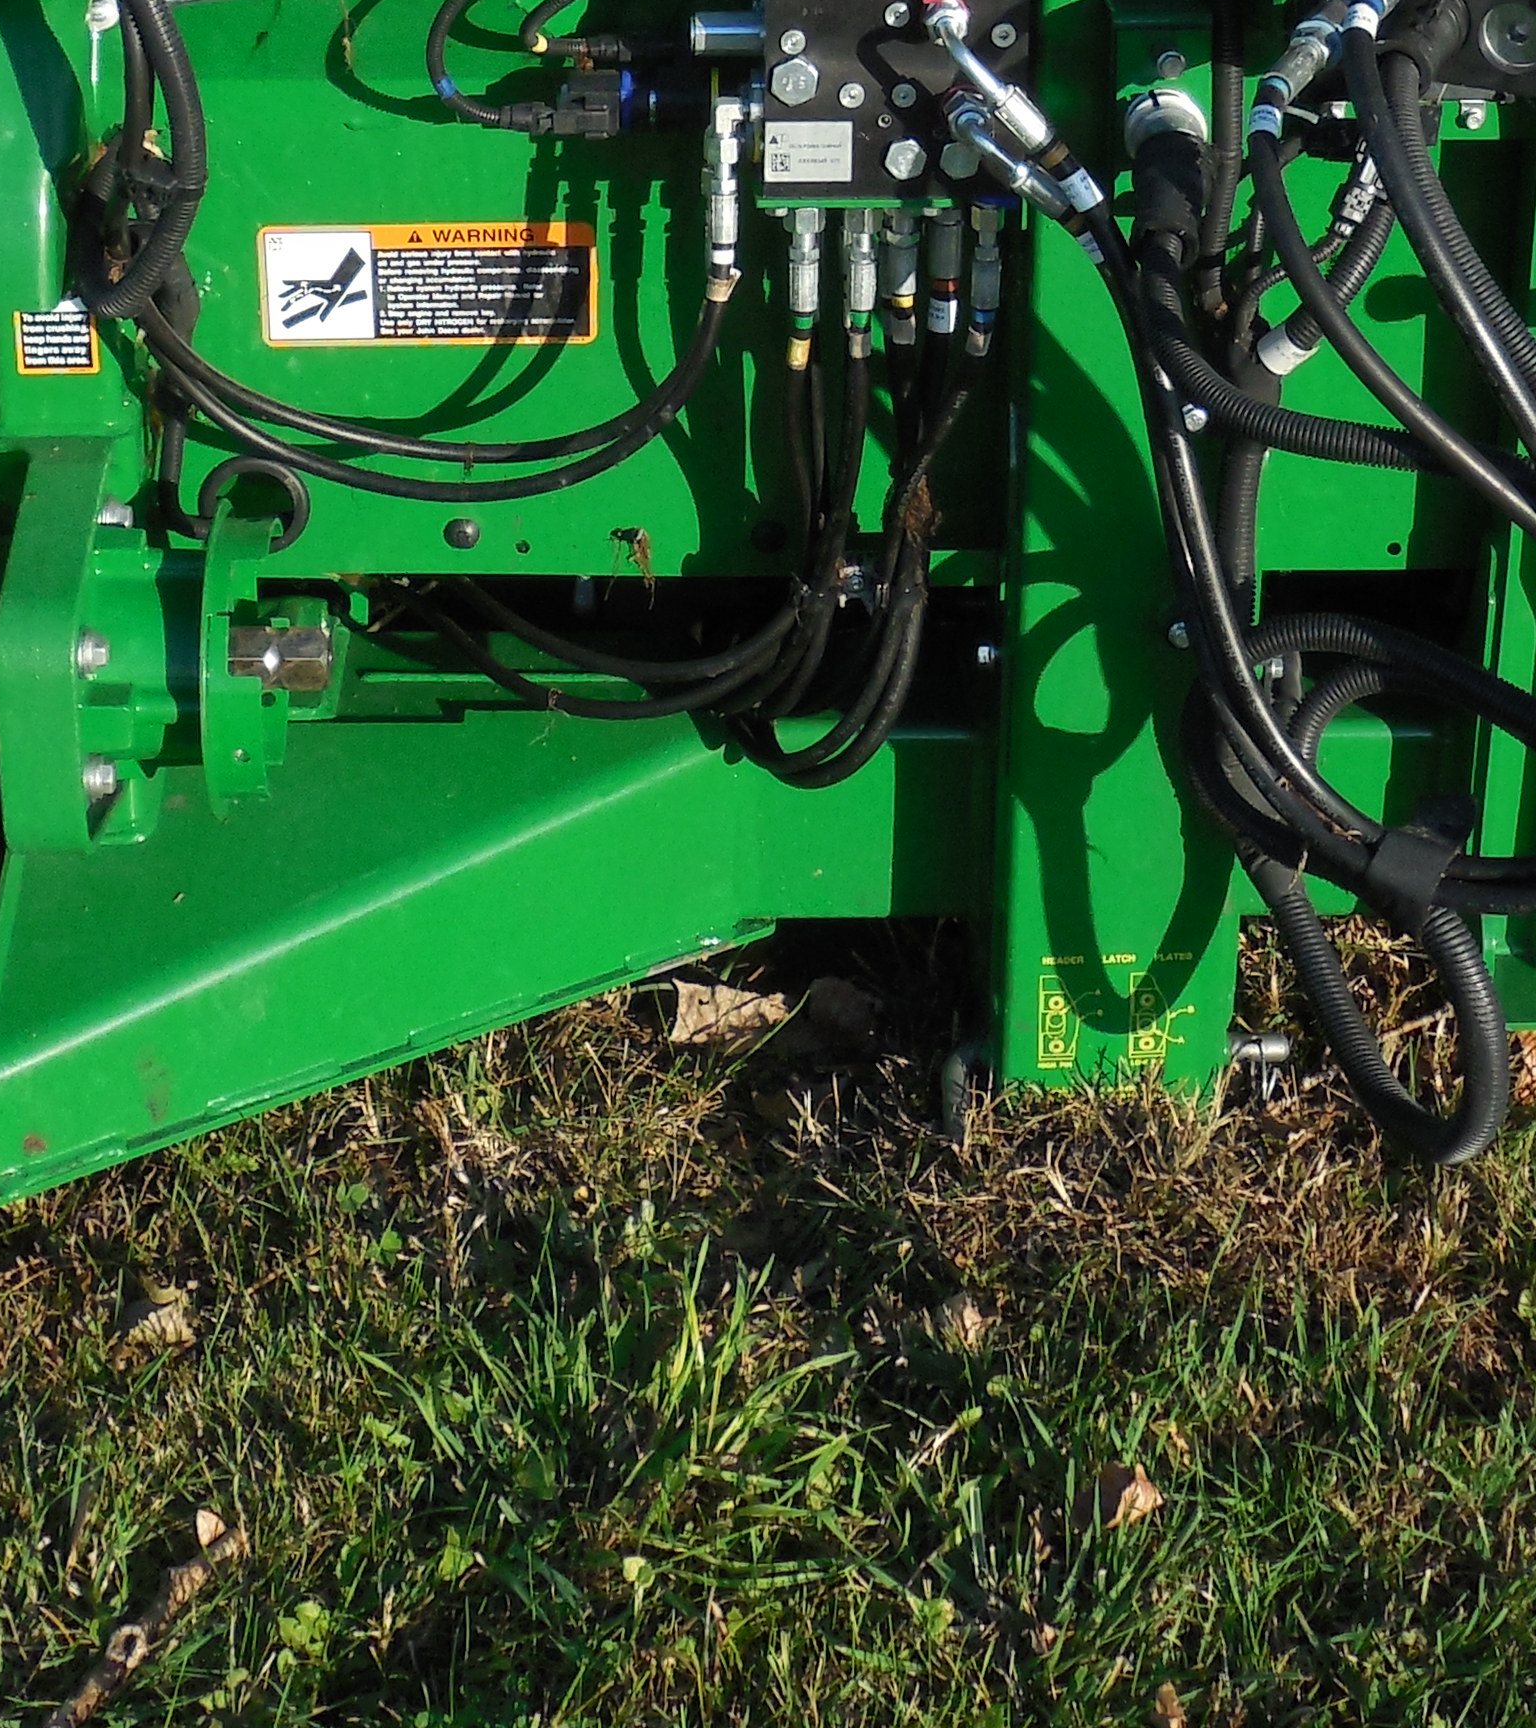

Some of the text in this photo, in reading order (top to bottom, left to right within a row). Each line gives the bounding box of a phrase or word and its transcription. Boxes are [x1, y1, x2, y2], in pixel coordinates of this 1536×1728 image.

[432, 228, 535, 243] WARNING
[23, 314, 33, 322] To
[34, 314, 60, 322] avoid
[23, 325, 44, 333] from
[46, 336, 72, 344] hands
[73, 336, 89, 344] and
[24, 347, 87, 355] fingers away
[25, 357, 46, 365] from
[1042, 952, 1193, 965] HEADER LATCH PLATES
